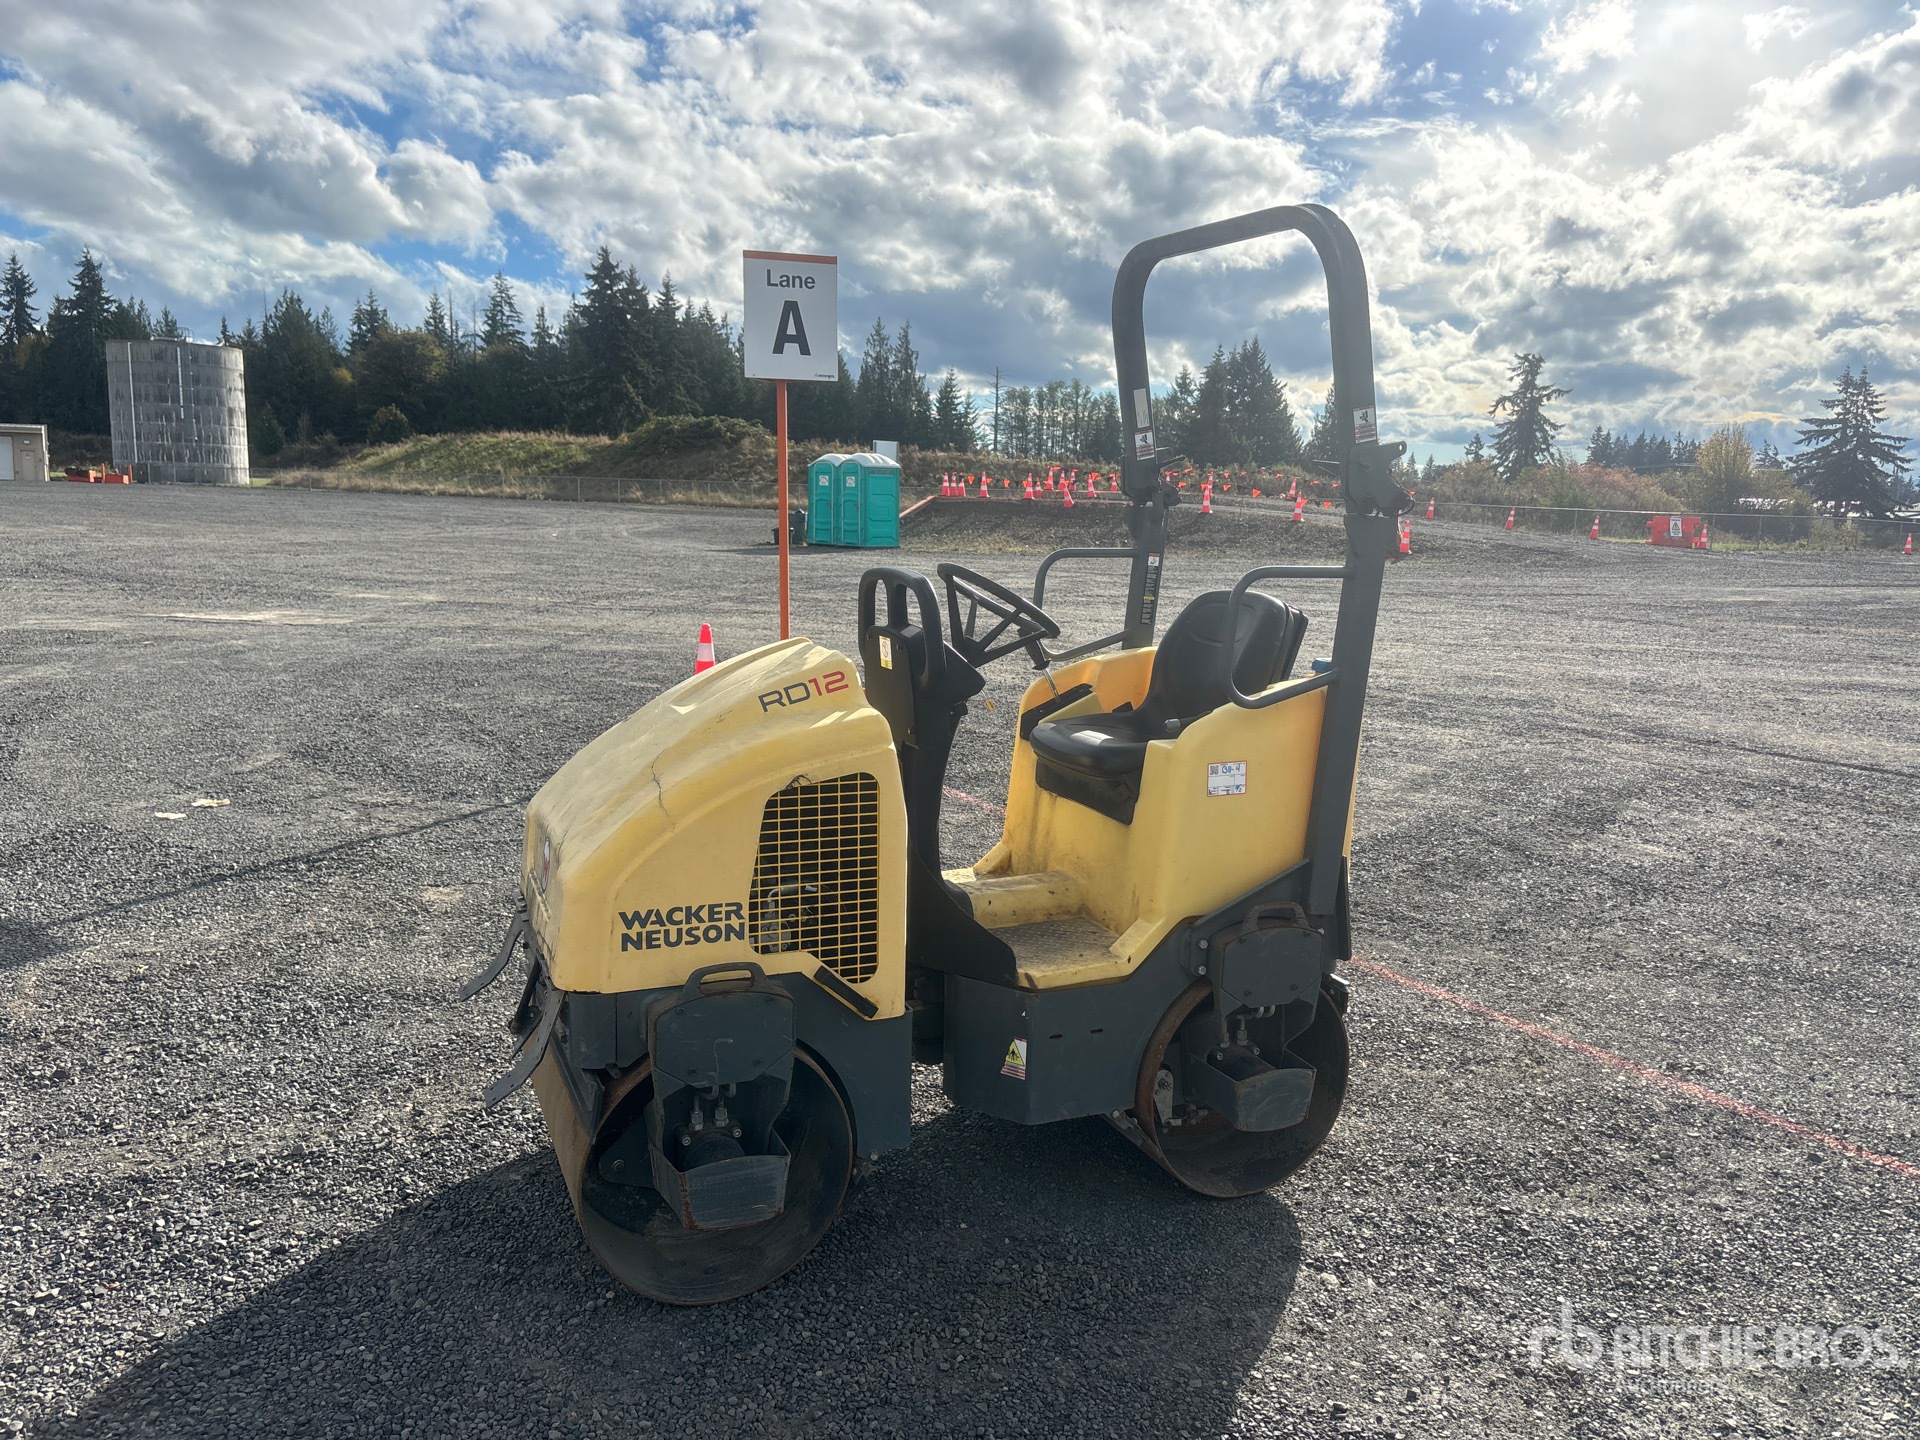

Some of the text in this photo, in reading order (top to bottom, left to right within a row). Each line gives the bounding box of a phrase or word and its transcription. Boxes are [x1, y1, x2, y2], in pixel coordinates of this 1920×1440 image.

[766, 269, 816, 289] Lane
[772, 300, 811, 356] A
[758, 671, 849, 713] RD12
[618, 902, 746, 930] WACKER
[621, 922, 745, 952] NEUSON
